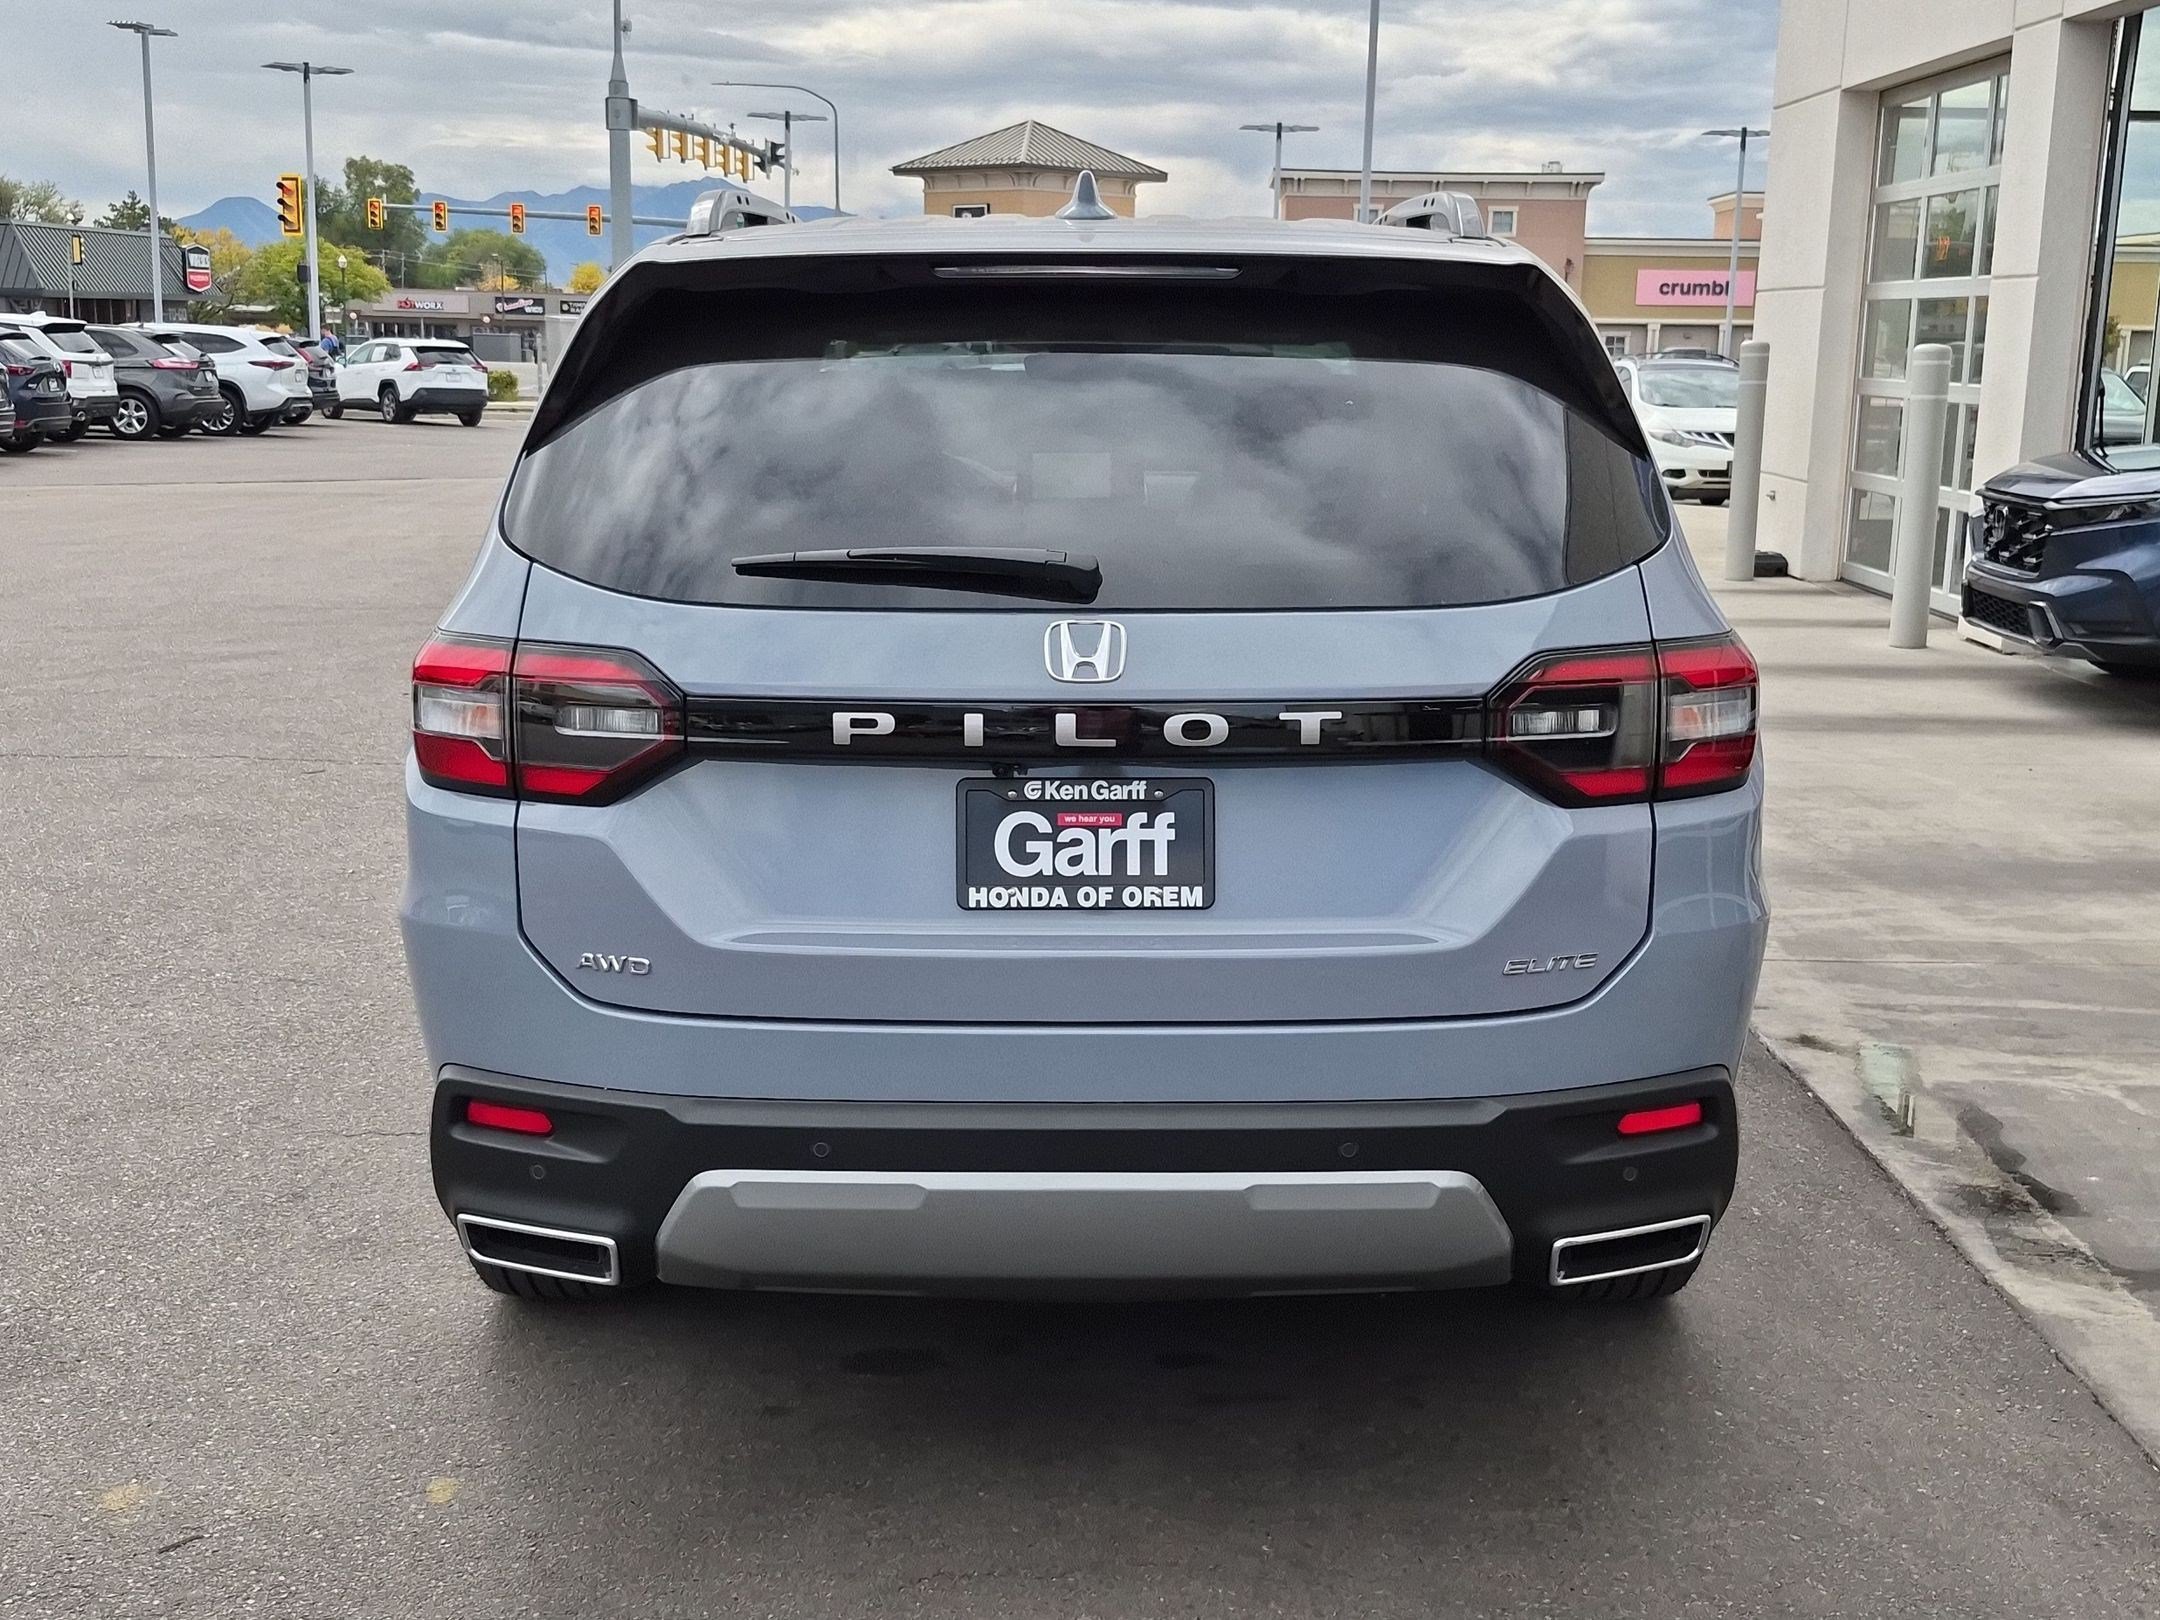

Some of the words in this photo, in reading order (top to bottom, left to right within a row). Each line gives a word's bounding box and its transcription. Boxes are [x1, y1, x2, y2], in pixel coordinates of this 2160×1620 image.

[1659, 280, 1730, 296] crumbl
[832, 711, 1343, 747] PILOT
[1044, 780, 1088, 800] Ken
[1091, 780, 1147, 800] Garff
[1078, 815, 1097, 823] hear
[1098, 816, 1115, 825] you
[993, 810, 1177, 877] Garff
[968, 886, 1063, 908] HONDA
[1076, 886, 1114, 908] OF
[1122, 886, 1204, 908] OREM
[576, 952, 651, 975] AWD
[1503, 952, 1600, 975] ELITE
